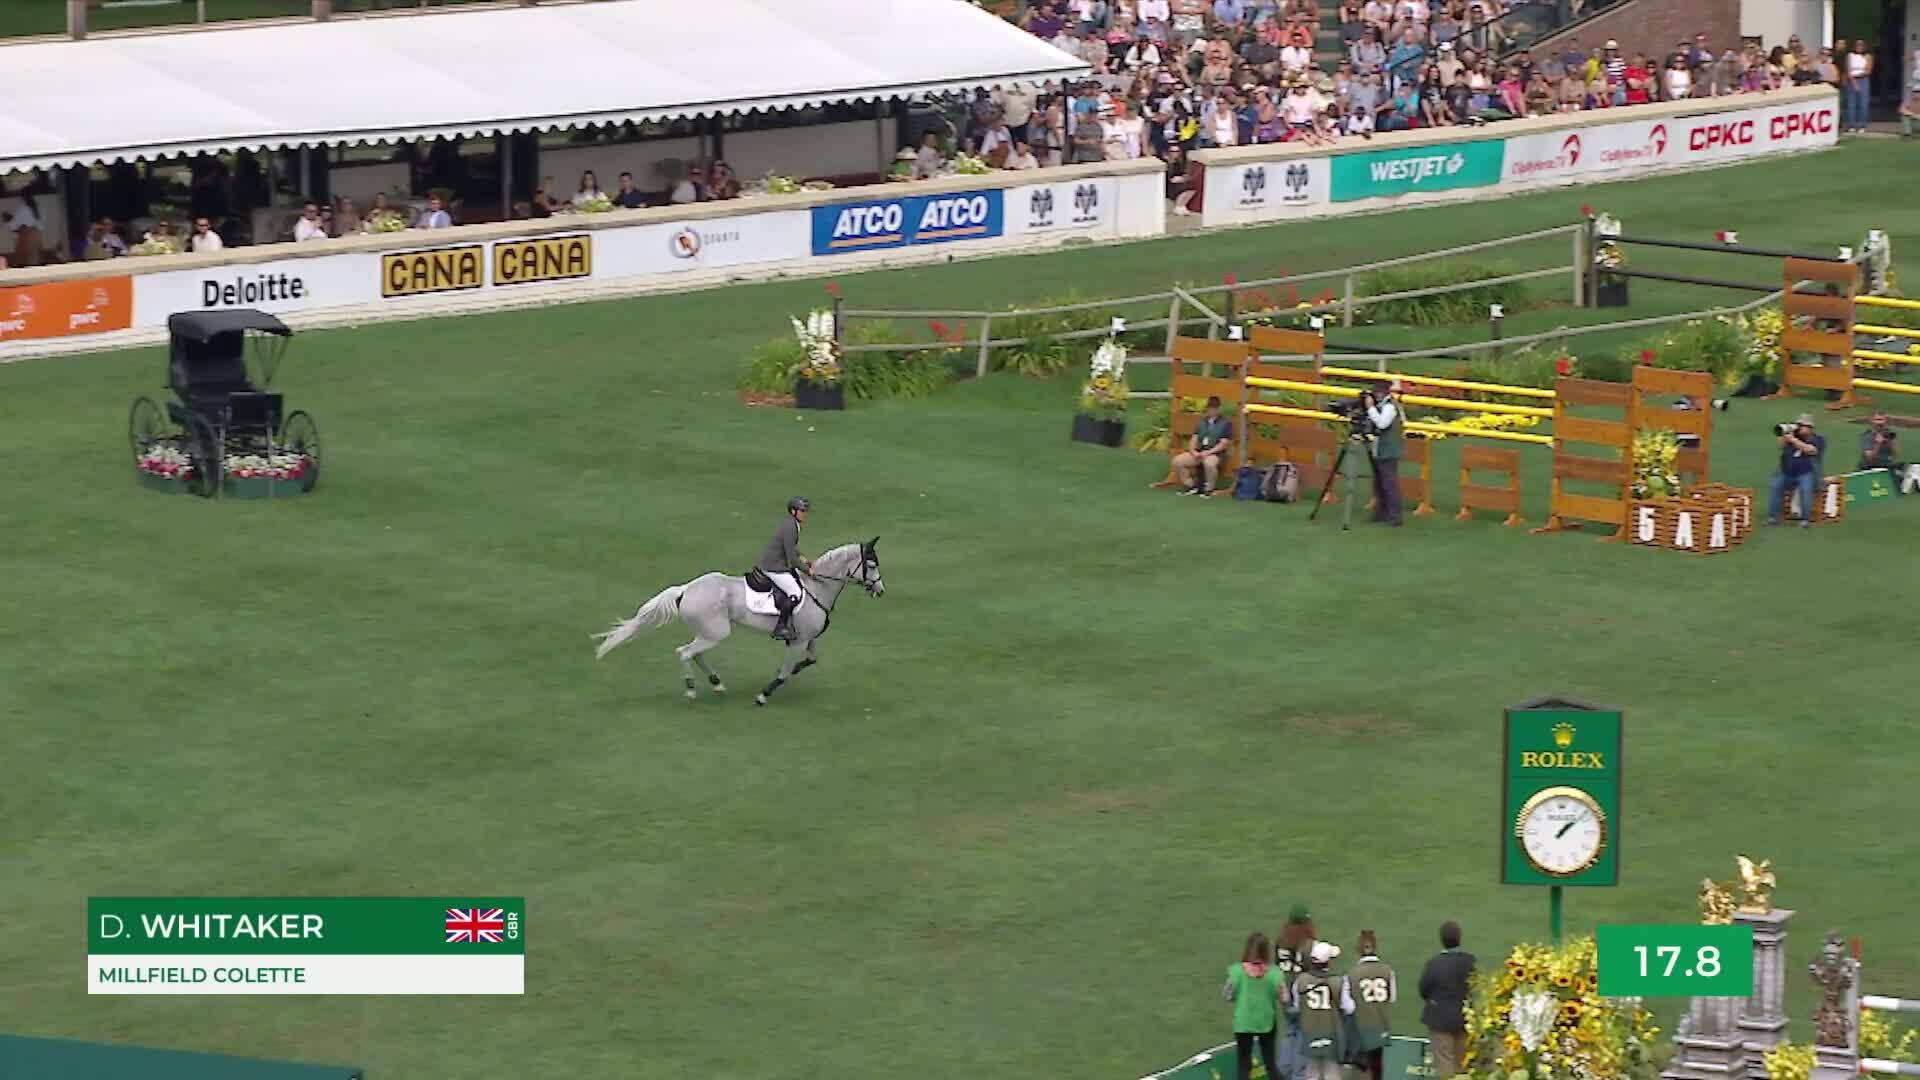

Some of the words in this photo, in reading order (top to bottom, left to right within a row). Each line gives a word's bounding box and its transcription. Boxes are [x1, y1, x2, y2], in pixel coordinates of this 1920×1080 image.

[1689, 120, 1754, 151] CPKC
[1770, 109, 1831, 141] CPKC
[1370, 155, 1448, 184] WESTJET
[832, 204, 903, 237] ATCO
[919, 196, 988, 229] ATCO
[389, 252, 477, 291] CANA
[502, 241, 585, 280] CANA
[203, 273, 309, 307] Deloitte.
[1520, 751, 1606, 770] ROLEX
[1306, 983, 1333, 1010] 51
[1359, 977, 1389, 1003] 26
